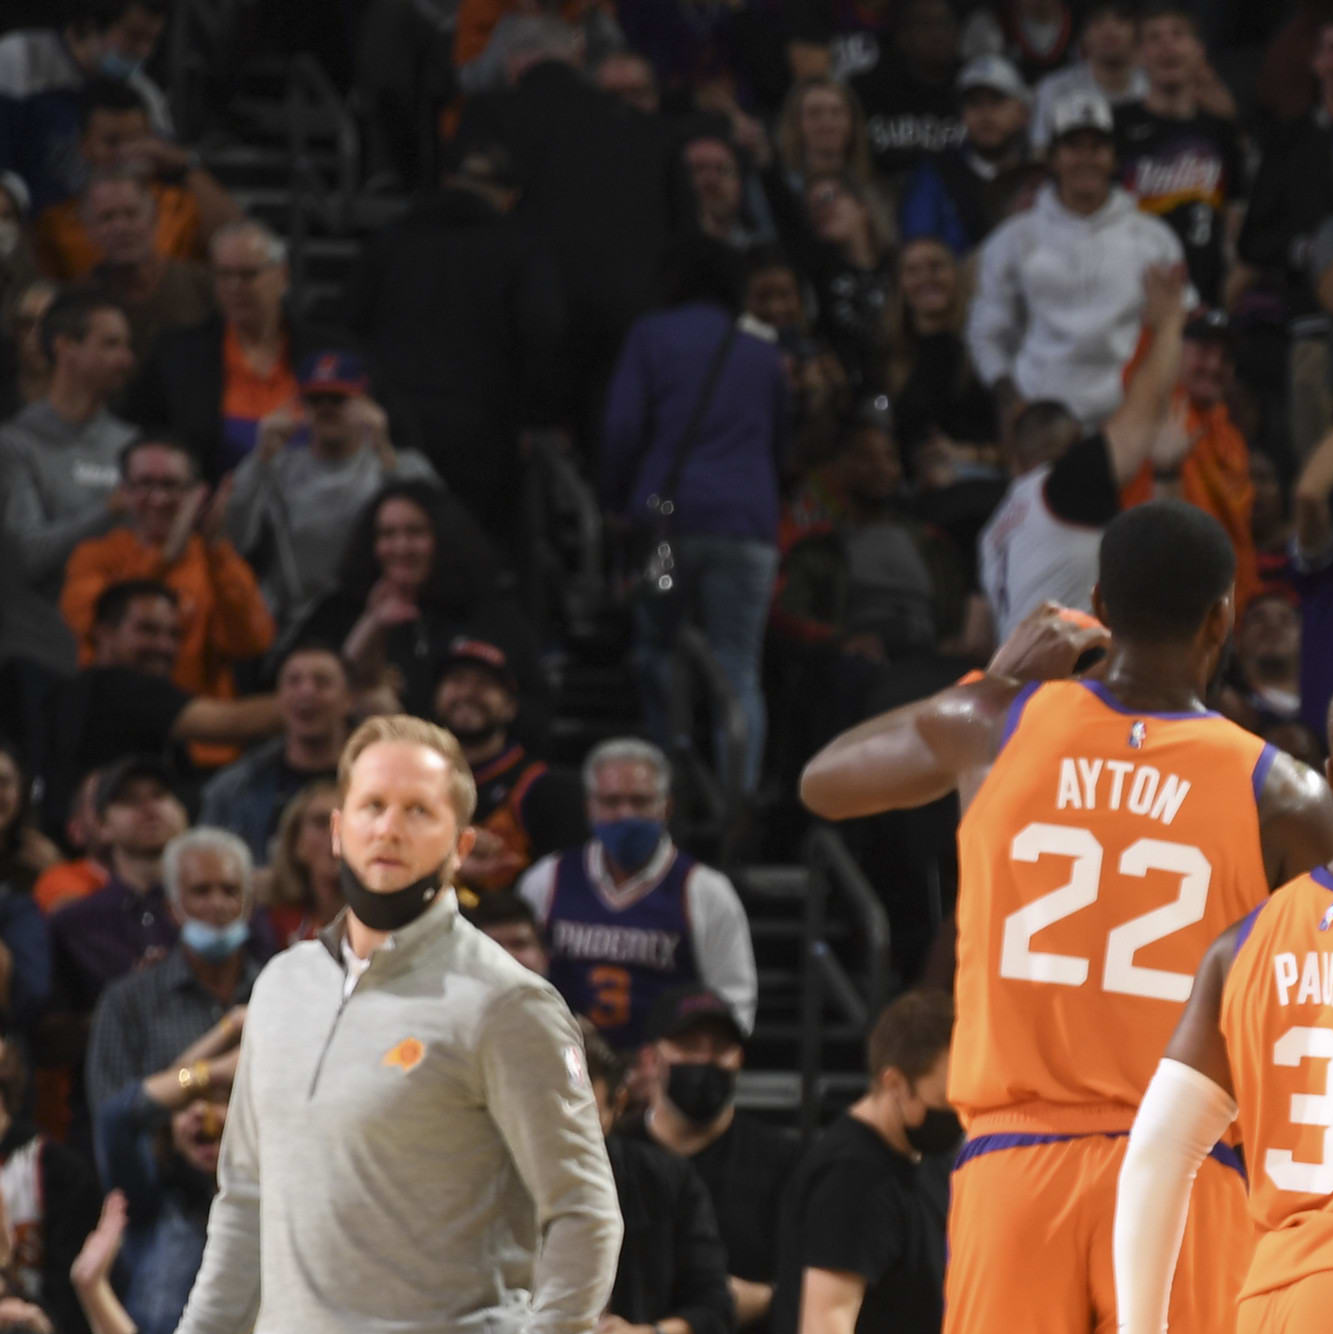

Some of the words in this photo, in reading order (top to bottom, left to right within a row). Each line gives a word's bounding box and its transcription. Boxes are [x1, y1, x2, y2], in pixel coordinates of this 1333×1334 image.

[1057, 758, 1190, 823] AYTON
[999, 823, 1213, 1003] 22
[556, 923, 678, 969] PHOENIX
[588, 966, 631, 1025] 3
